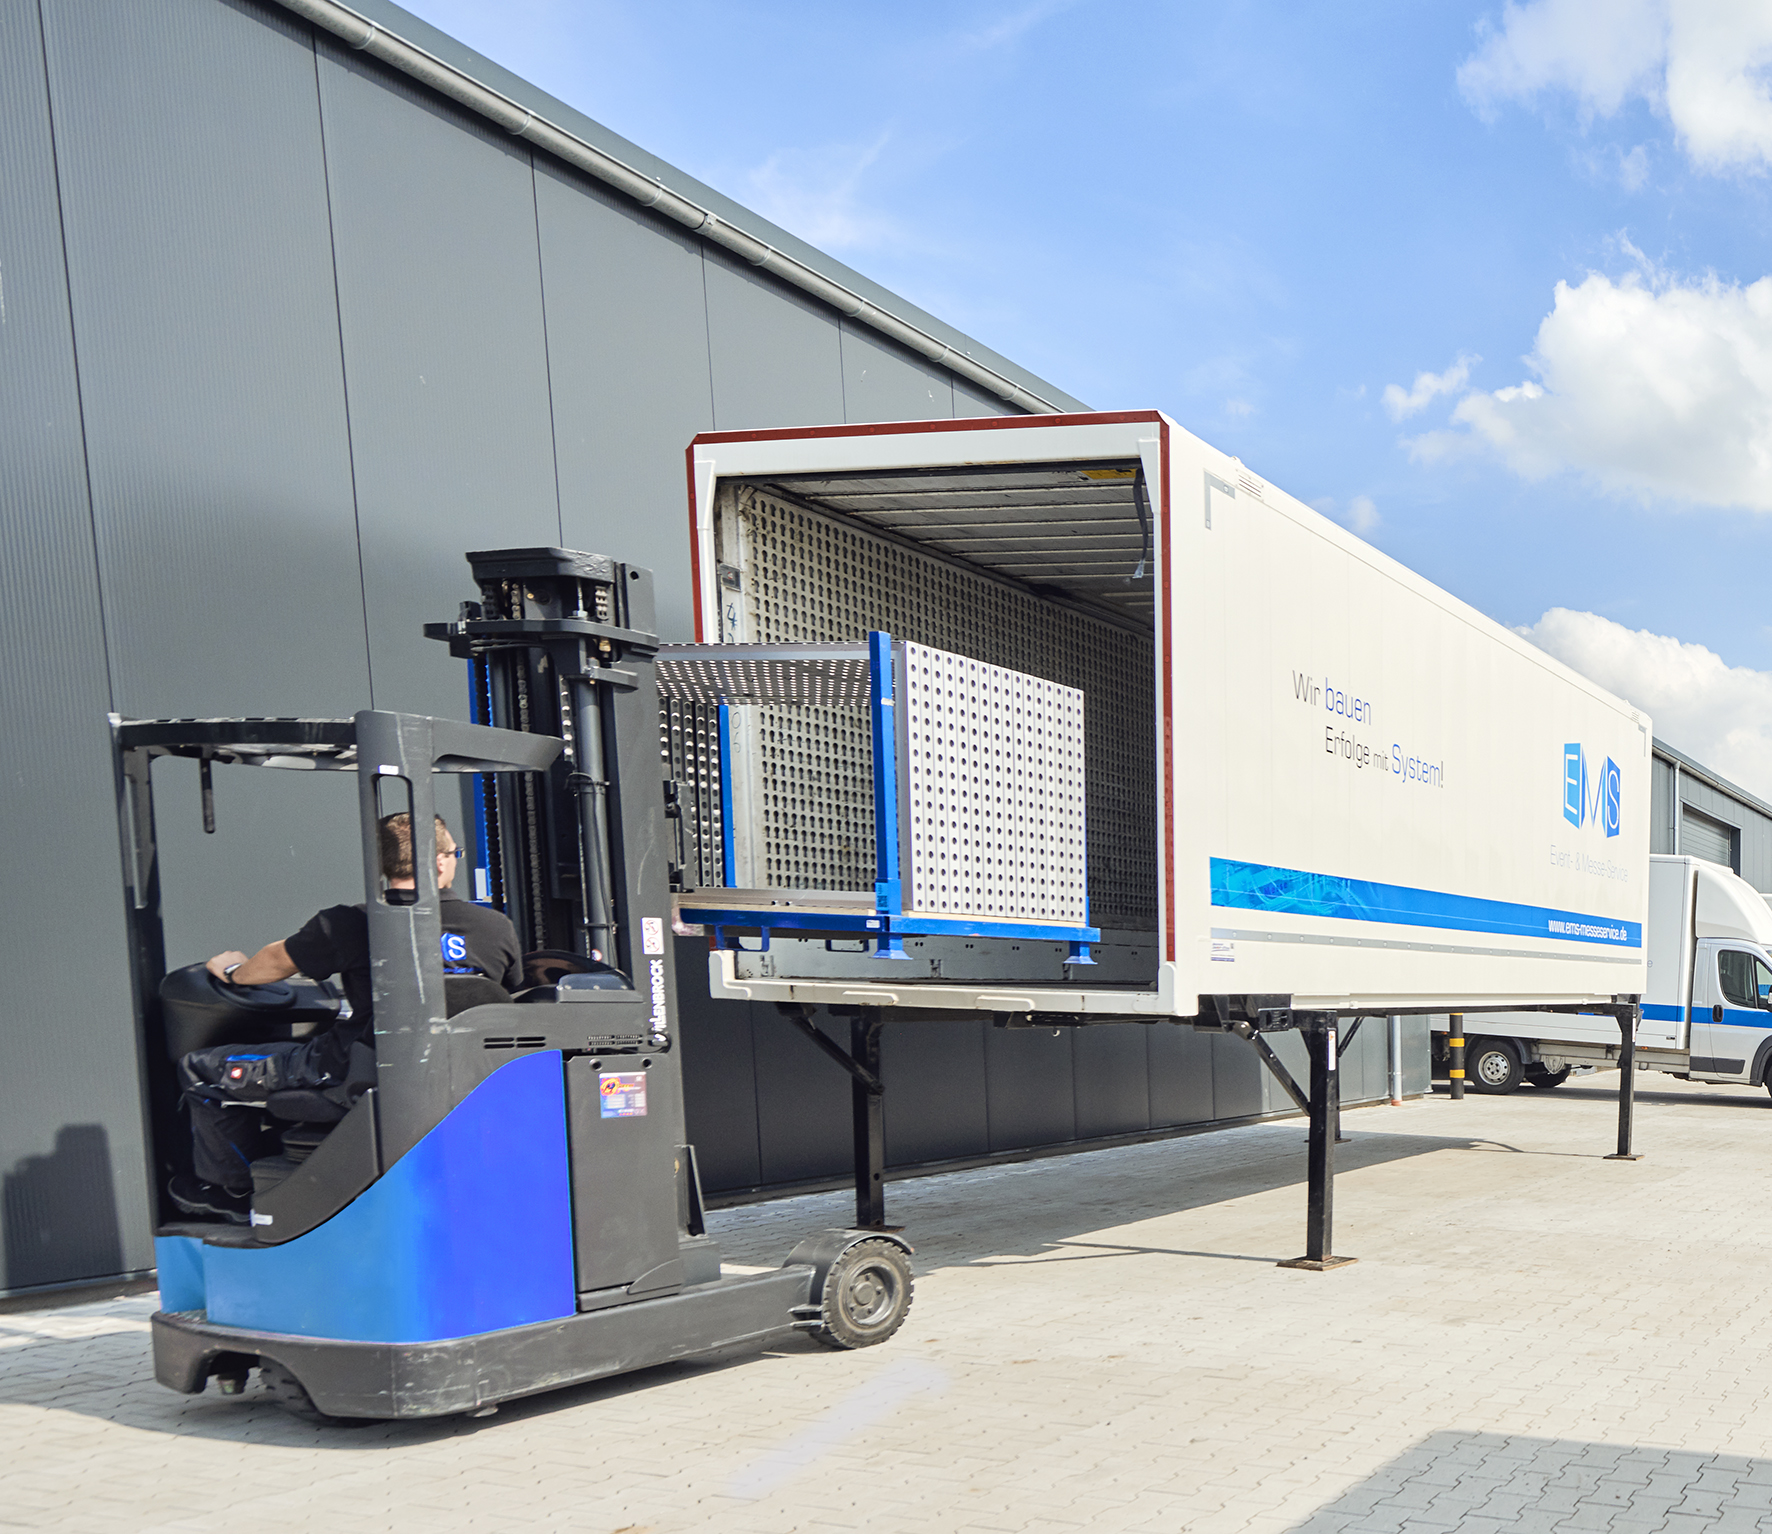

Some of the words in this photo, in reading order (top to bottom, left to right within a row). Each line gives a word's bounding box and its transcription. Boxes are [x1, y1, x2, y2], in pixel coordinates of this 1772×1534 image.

[1292, 669, 1321, 706] Wir
[1325, 676, 1372, 726] bauen
[1325, 725, 1370, 769] Erfolge
[1373, 750, 1389, 772] mit
[1391, 743, 1444, 789] System!
[1563, 743, 1621, 838] EMS
[1550, 844, 1573, 869] Event-
[1548, 919, 1628, 942] www.ems-messeservice.de
